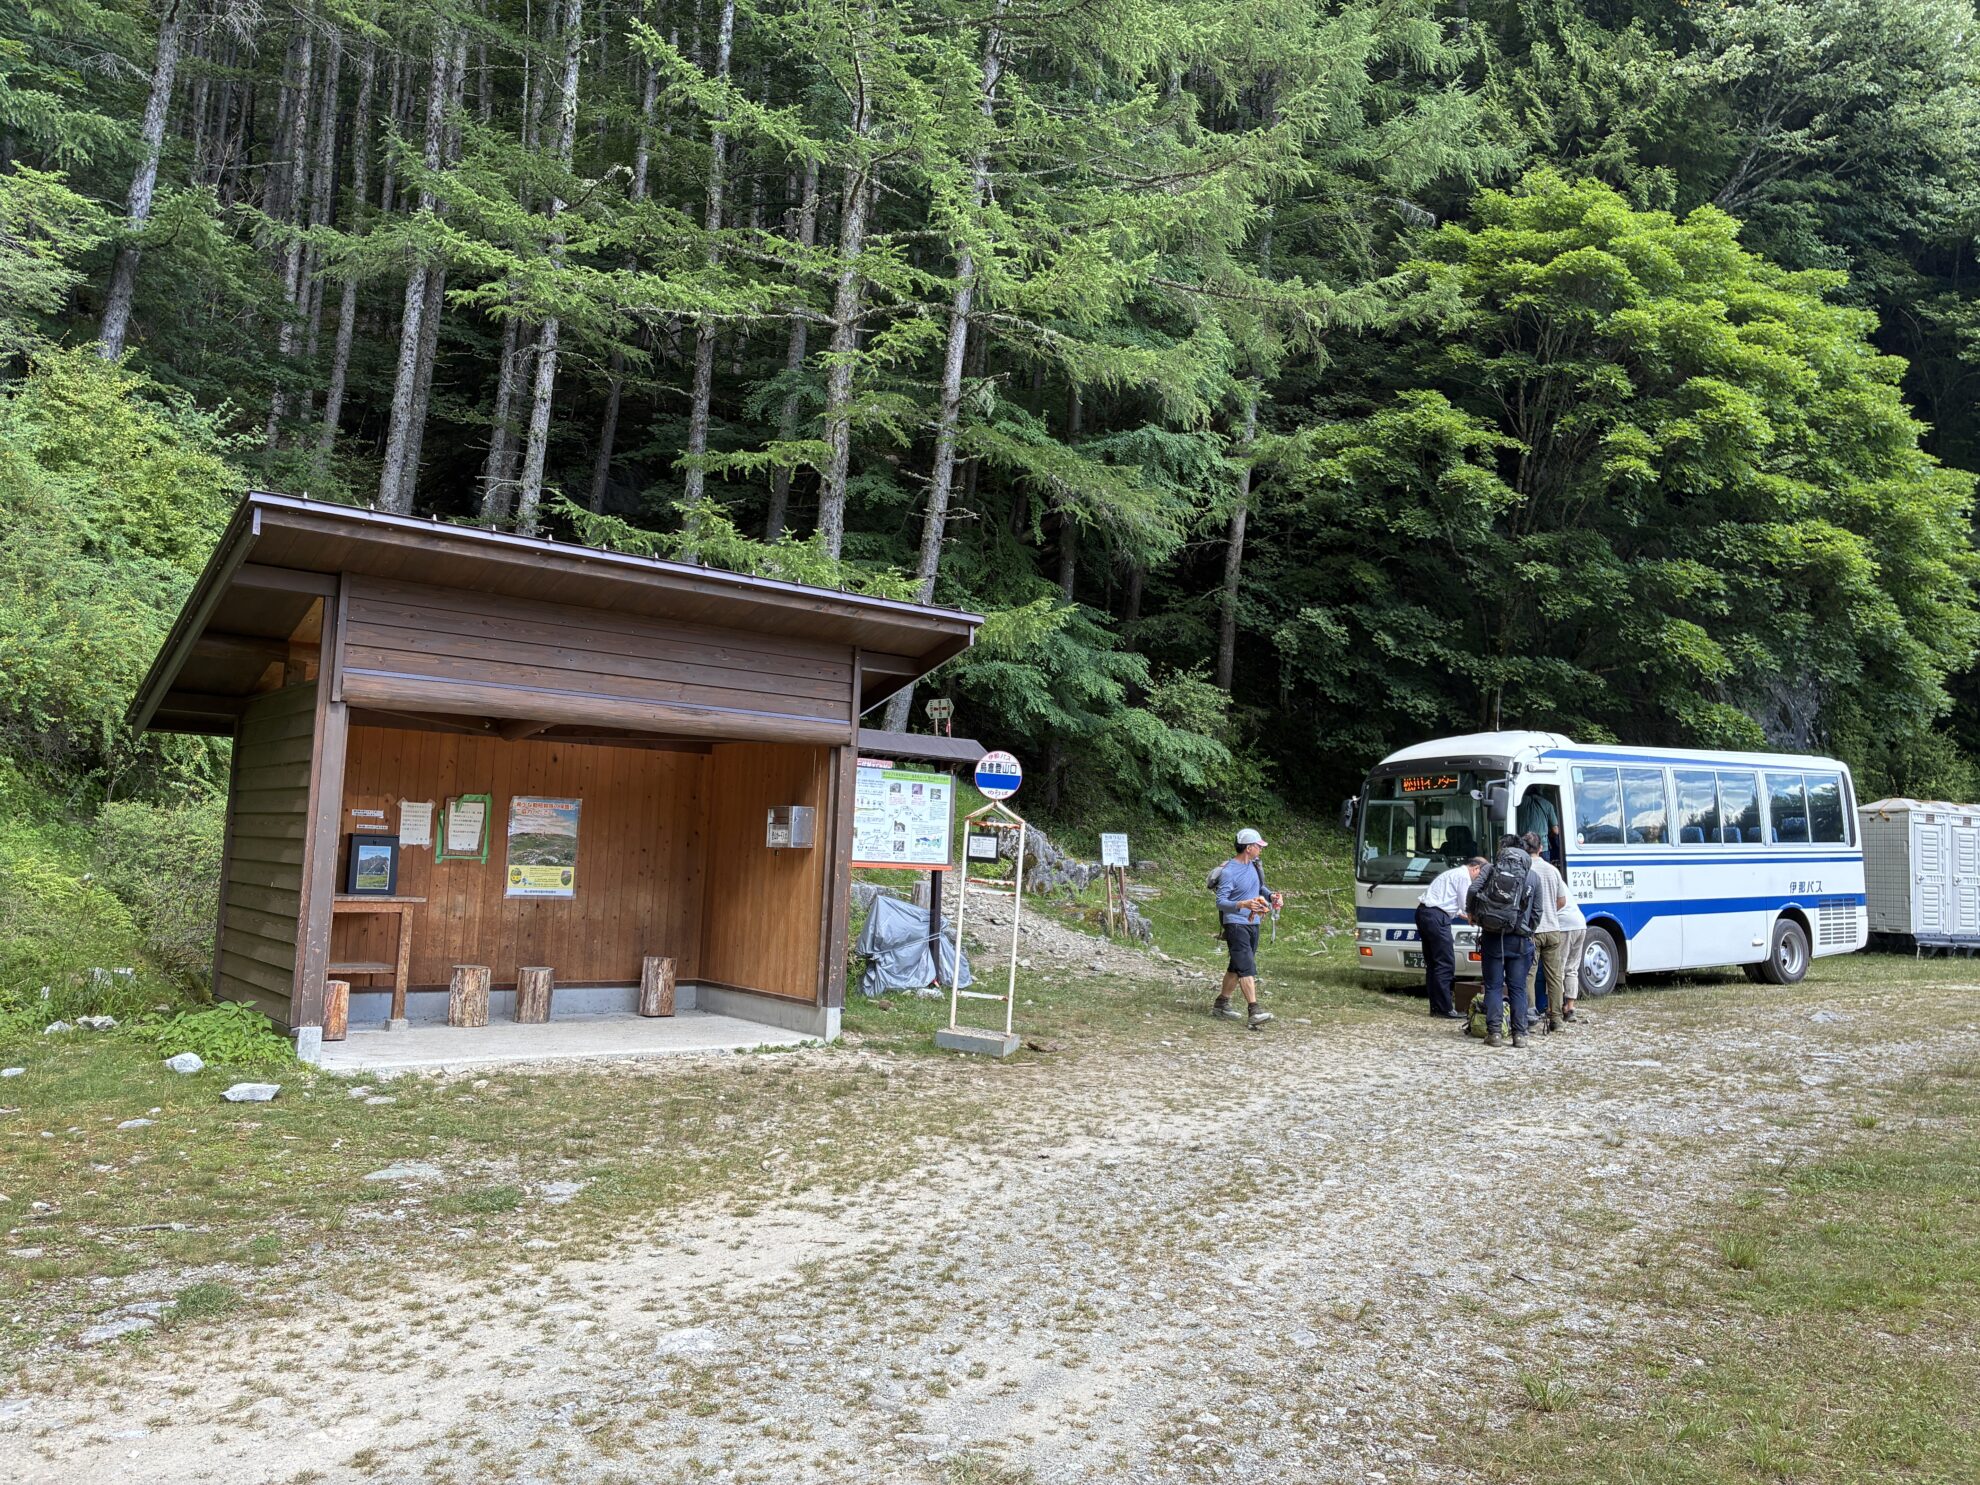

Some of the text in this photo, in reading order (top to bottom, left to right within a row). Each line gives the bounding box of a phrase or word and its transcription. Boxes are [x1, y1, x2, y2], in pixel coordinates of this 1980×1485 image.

[980, 762, 1017, 775] 鳥倉登山口
[1572, 879, 1592, 887] 出入口
[1789, 880, 1823, 893] 伊那バス
